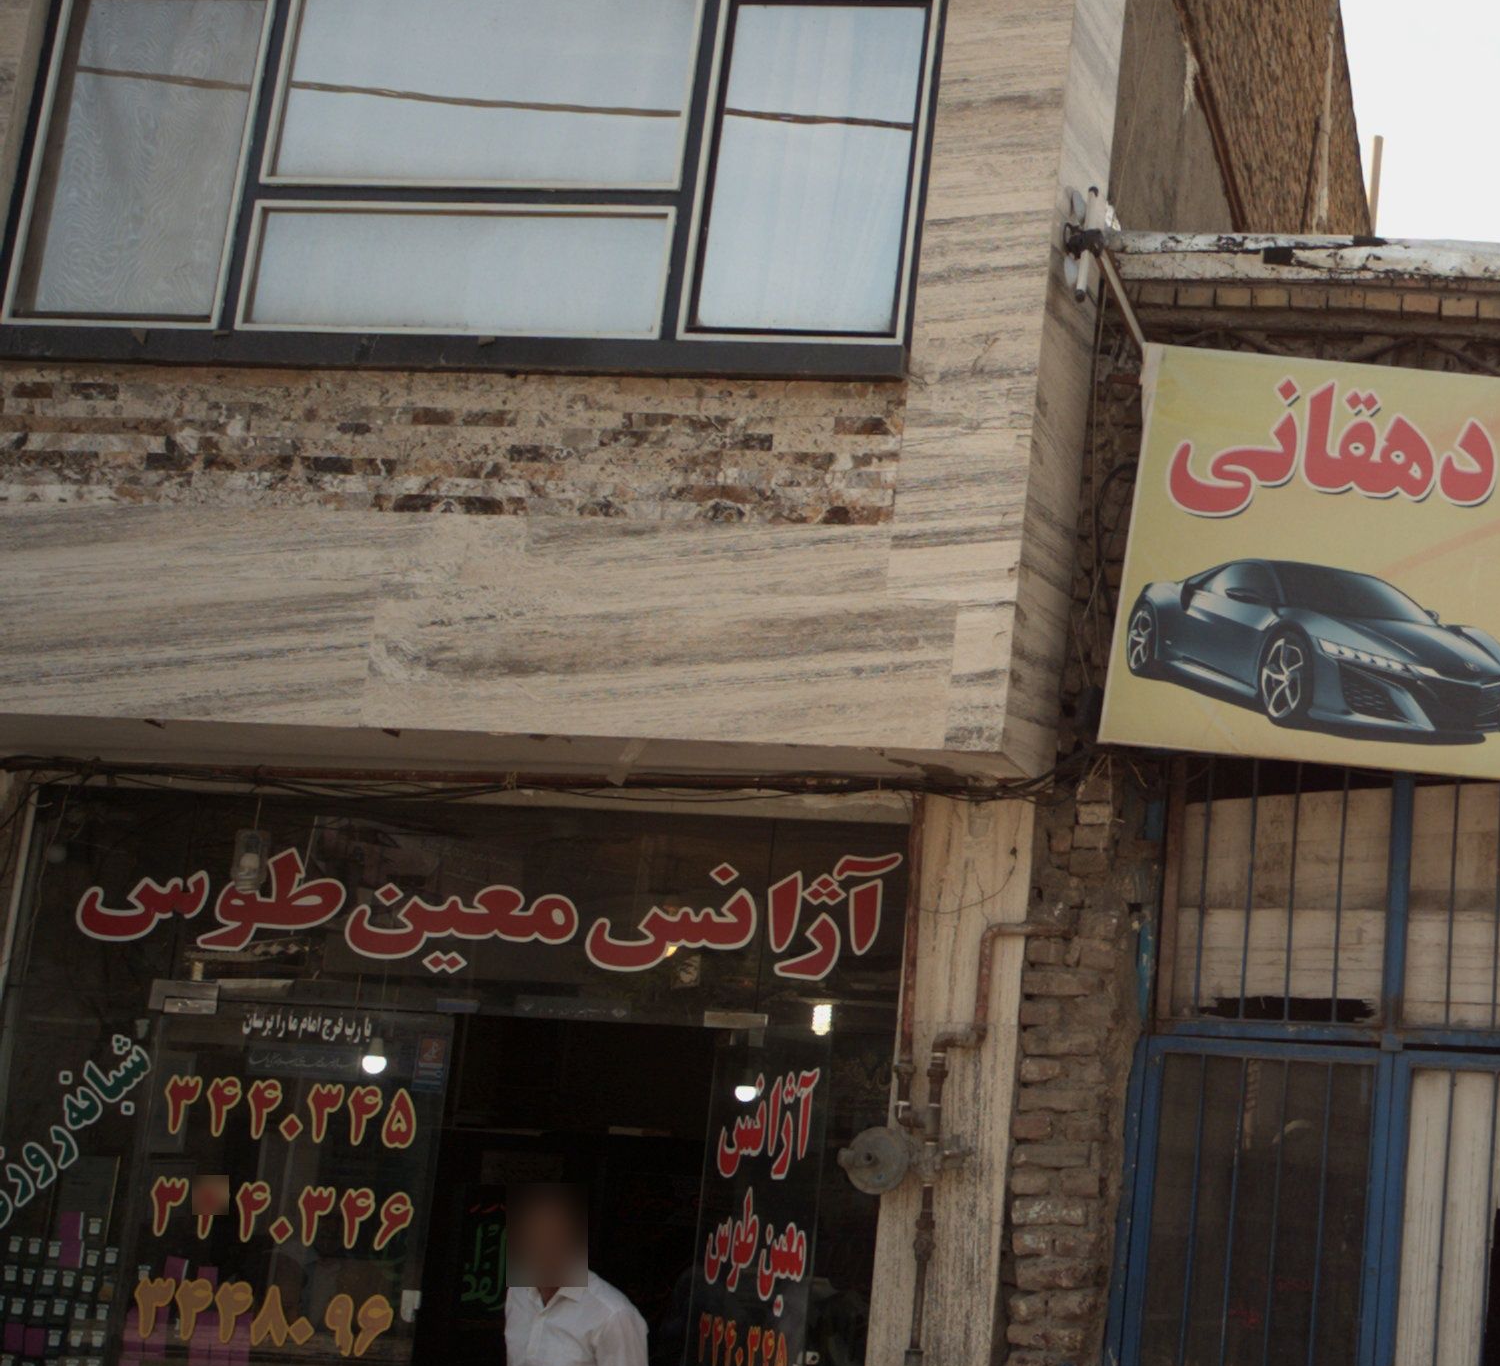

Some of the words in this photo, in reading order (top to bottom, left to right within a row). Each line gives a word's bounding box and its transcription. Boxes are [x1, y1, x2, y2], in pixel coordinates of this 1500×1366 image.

[1169, 378, 1496, 517] دهقانی
[76, 848, 346, 951] طوس
[345, 882, 579, 973] معین
[585, 852, 903, 980] آژانس
[298, 1010, 322, 1039] امام
[321, 1012, 344, 1042] فرج
[59, 1034, 151, 1130] شبانه
[718, 1067, 820, 1180] آژانس
[705, 1186, 760, 1293] طوس
[757, 1221, 807, 1317] معین
